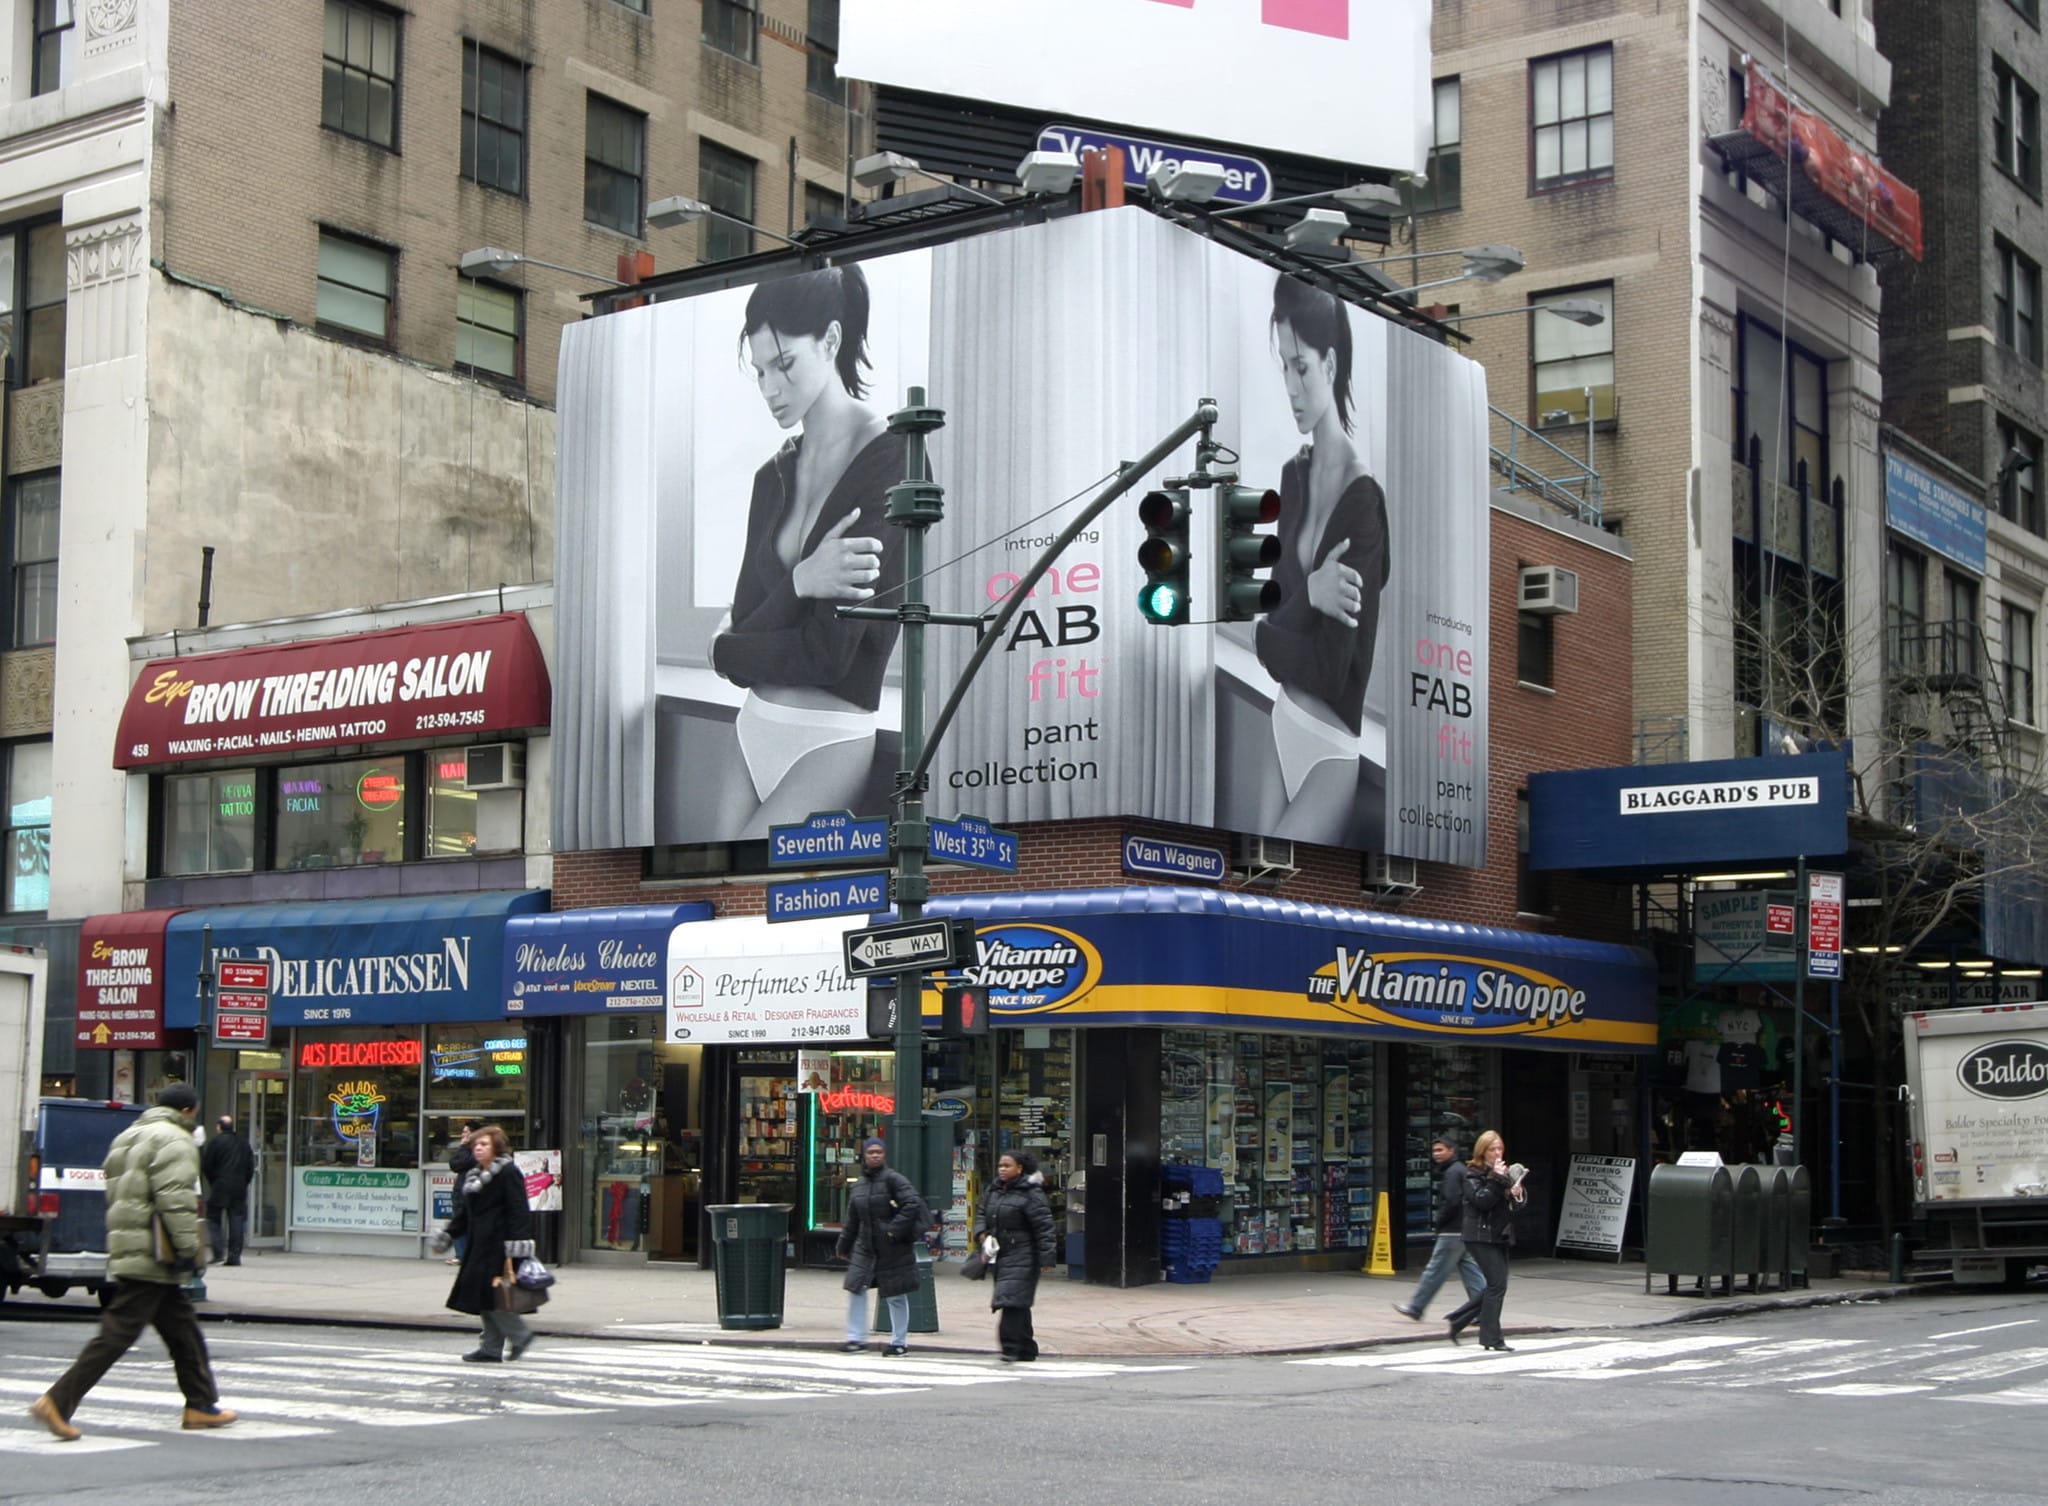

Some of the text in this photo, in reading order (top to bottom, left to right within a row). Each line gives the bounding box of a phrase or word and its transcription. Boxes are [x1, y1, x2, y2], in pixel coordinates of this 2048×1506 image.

[1129, 145, 1257, 191] Waer
[1005, 531, 1099, 551] introding
[985, 563, 1100, 602] one
[1426, 610, 1472, 636] introducing
[1416, 639, 1472, 676] one
[145, 669, 195, 707] Eye
[184, 650, 492, 725] BROW THREADING SALON
[1025, 659, 1099, 702] fit
[1411, 671, 1473, 719] FAB
[416, 709, 485, 730] 212-594-7545
[168, 719, 386, 754] WAXING FACIAL NAILS HENNA TATTOO
[1023, 717, 1098, 750] pant
[1437, 723, 1472, 766] fit
[132, 744, 149, 757] 458
[949, 757, 1097, 788] collection
[1437, 780, 1472, 802] pant
[1627, 783, 1811, 808] BLAGGARD'S PUB
[219, 801, 254, 816] TATTOO
[286, 797, 320, 811] FACIAL
[811, 817, 846, 829] 450-460
[1399, 804, 1472, 834] collection
[777, 829, 882, 856] Seventh Ave
[934, 829, 1012, 862] West 35th St
[1135, 842, 1216, 871] Van Wagner
[775, 884, 880, 912] Fashion Ave
[1702, 896, 1759, 920] SAMPLE
[92, 940, 114, 960] Eye
[112, 948, 148, 967] BROW
[515, 939, 657, 973] Wireless Choice
[864, 935, 940, 958] ONE WAY
[976, 939, 1077, 966] Vitamin
[86, 967, 152, 986] THREADING
[235, 968, 263, 976] STANDING
[256, 936, 471, 997] DELICATESSEN
[962, 965, 1065, 989] Shoppe
[98, 987, 138, 1005] SALON
[620, 979, 657, 991] NEXTEL
[715, 968, 808, 1006] Perfumes
[1308, 947, 1586, 1021] THE Vitamin Shoppe
[1931, 985, 1968, 998] SHE
[1022, 994, 1046, 1005] 1977
[304, 1008, 351, 1020] SINCE 1976
[724, 1011, 729, 1021] &
[1440, 1014, 1460, 1025] SINCE
[1728, 1020, 1749, 1031] NYC
[728, 1029, 766, 1038] SINCE 1990
[792, 1025, 851, 1038] 212-947-0368
[301, 1043, 325, 1067] AL'S
[329, 1040, 422, 1066] DELICATESSEN
[495, 1064, 522, 1074] REUBEN
[337, 1081, 378, 1097] SALADS
[1945, 1113, 2030, 1130] Baldor Specialty
